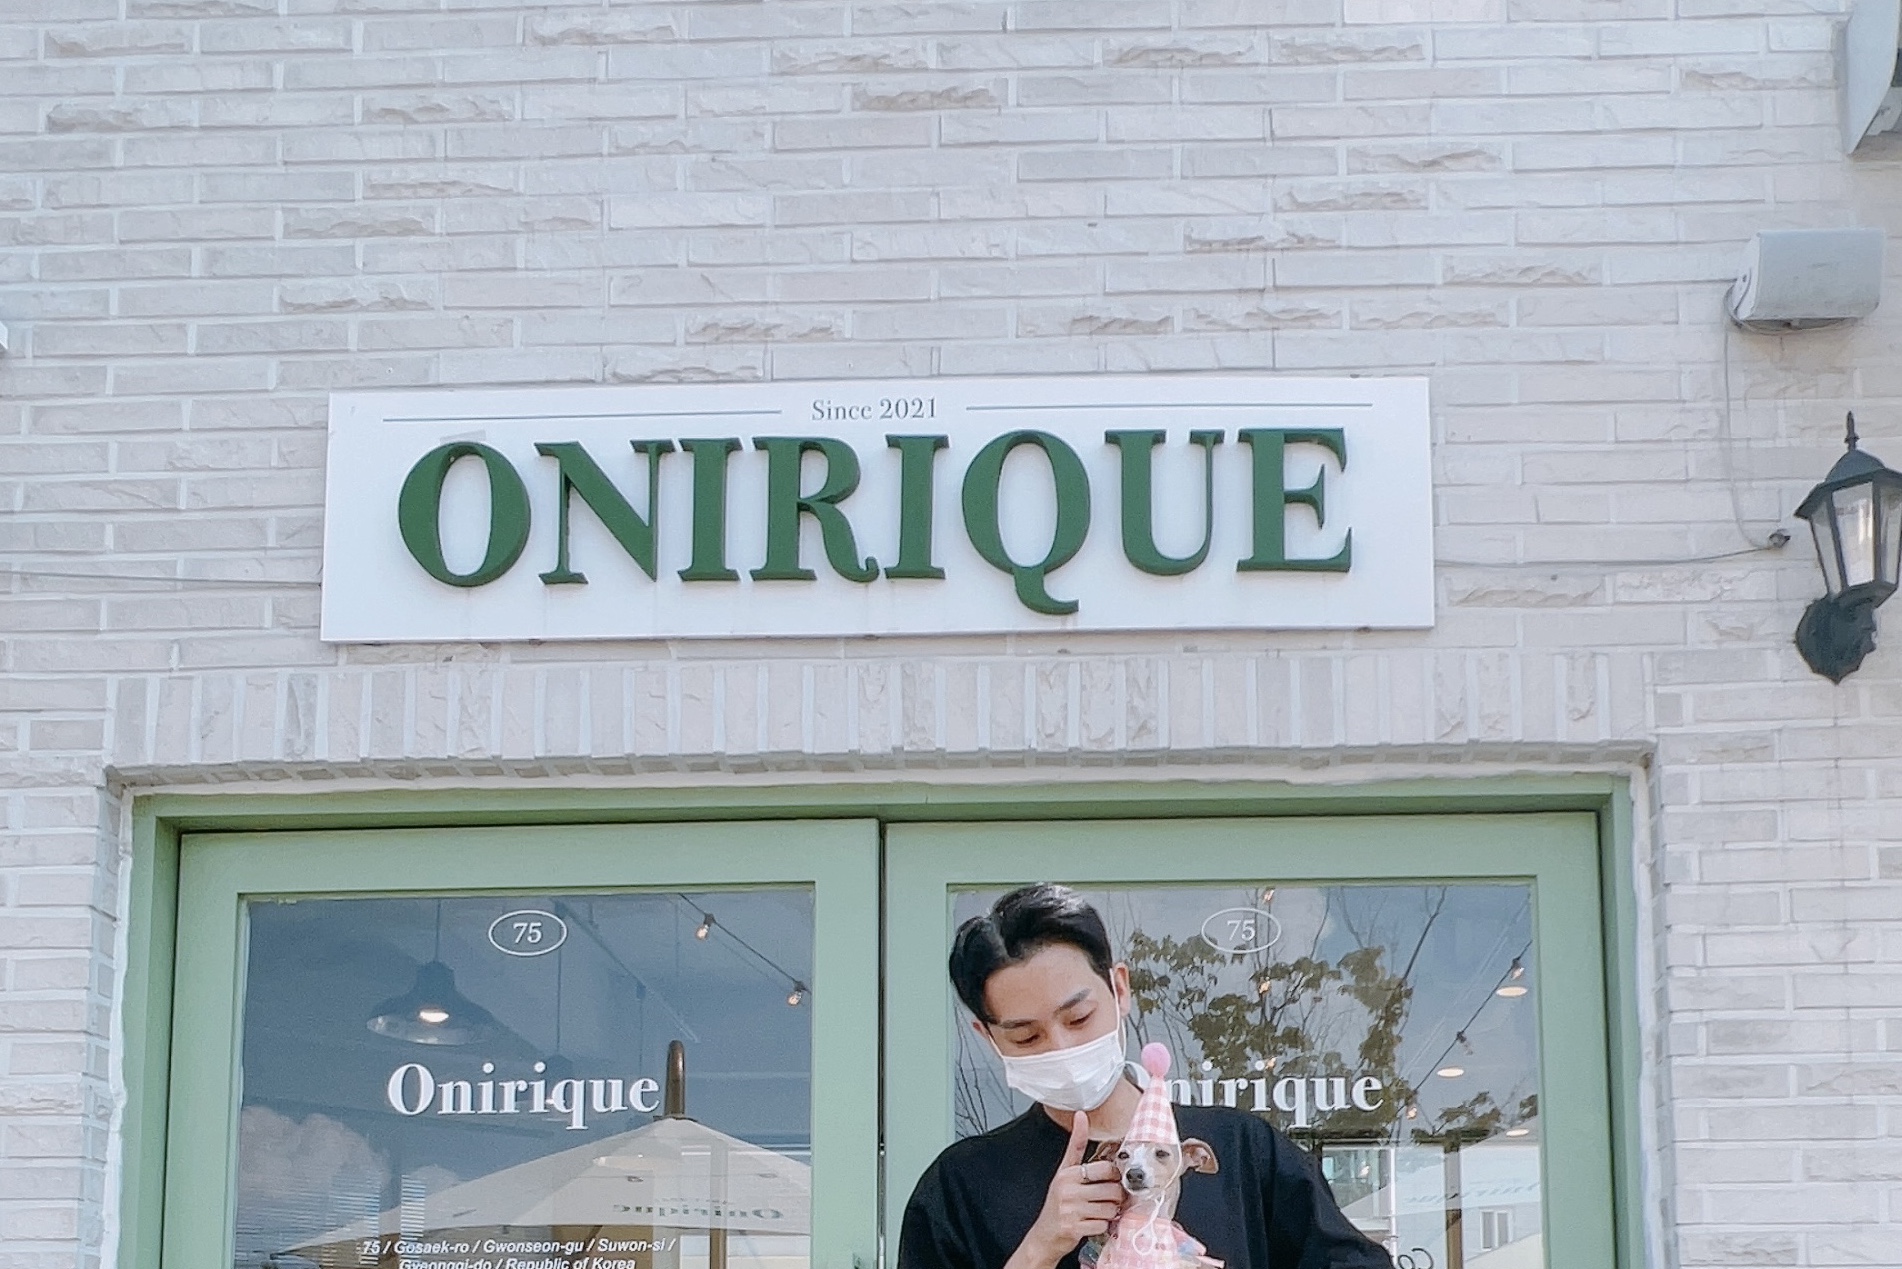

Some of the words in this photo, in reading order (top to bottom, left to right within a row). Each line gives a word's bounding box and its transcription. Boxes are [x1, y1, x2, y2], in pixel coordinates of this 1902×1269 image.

[812, 399, 872, 420] Since
[880, 397, 936, 419] 2021
[398, 427, 1353, 615] ONIRIQUE
[513, 922, 542, 943] 75
[1227, 920, 1256, 941] 75
[387, 1062, 661, 1130] Onirique
[362, 1240, 381, 1255] 75
[394, 1240, 469, 1254] Gosaek-ro
[483, 1239, 585, 1255] Gwonseon-gu
[597, 1237, 666, 1252] Suwon-si
